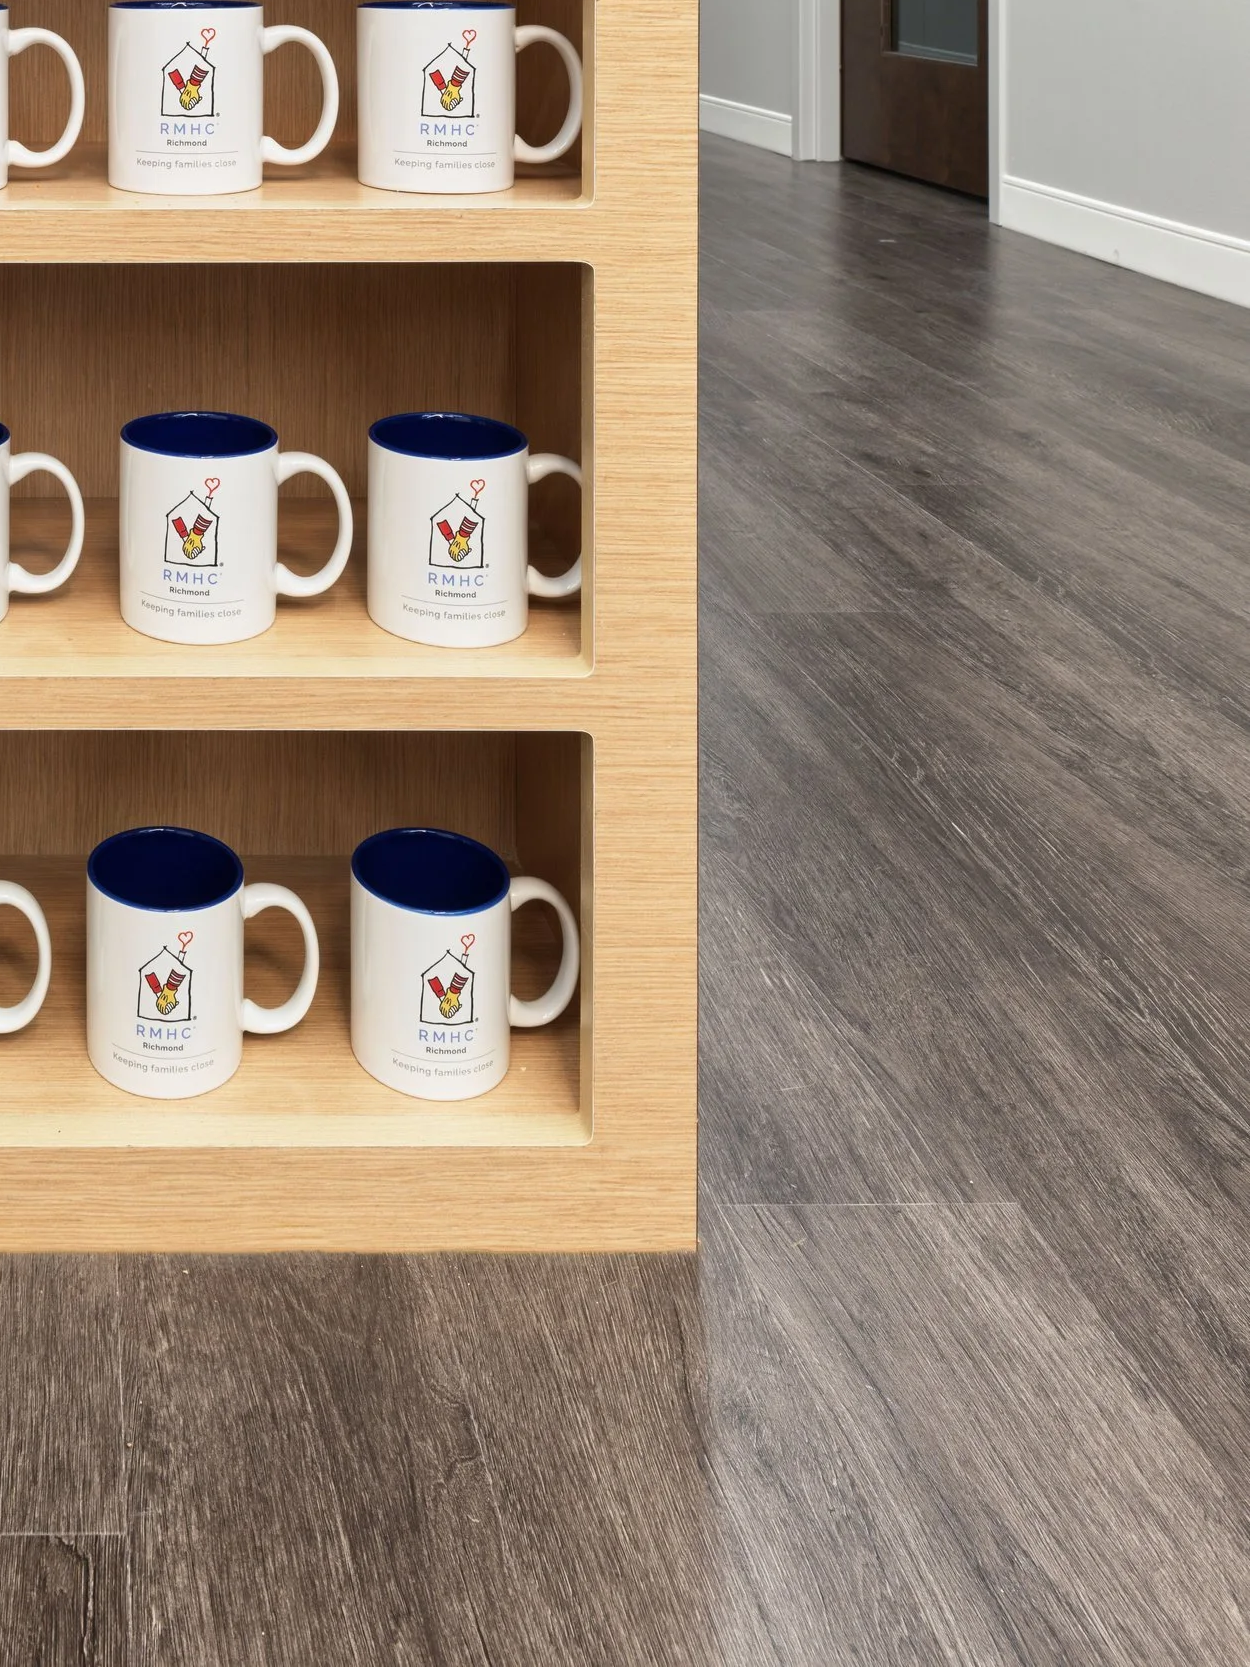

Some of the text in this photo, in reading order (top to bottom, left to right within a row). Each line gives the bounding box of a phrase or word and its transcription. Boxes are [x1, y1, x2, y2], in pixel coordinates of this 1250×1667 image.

[160, 123, 214, 134] RMHC
[420, 123, 474, 135] RMHC
[136, 158, 236, 169] Keeping families close
[394, 158, 495, 169] Keeping families close
[163, 569, 218, 585] RMHC
[428, 572, 484, 586] RMHC
[170, 587, 210, 596] Richmond
[435, 590, 476, 598] Richmond
[141, 599, 241, 618] Keeping families close
[403, 603, 506, 620] Keeping families close
[137, 1024, 191, 1040] RMHC
[419, 1029, 474, 1043] RMHC
[143, 1042, 183, 1051] Richmond
[113, 1052, 214, 1074] Keeping families close
[392, 1057, 494, 1077] Keeping families close
